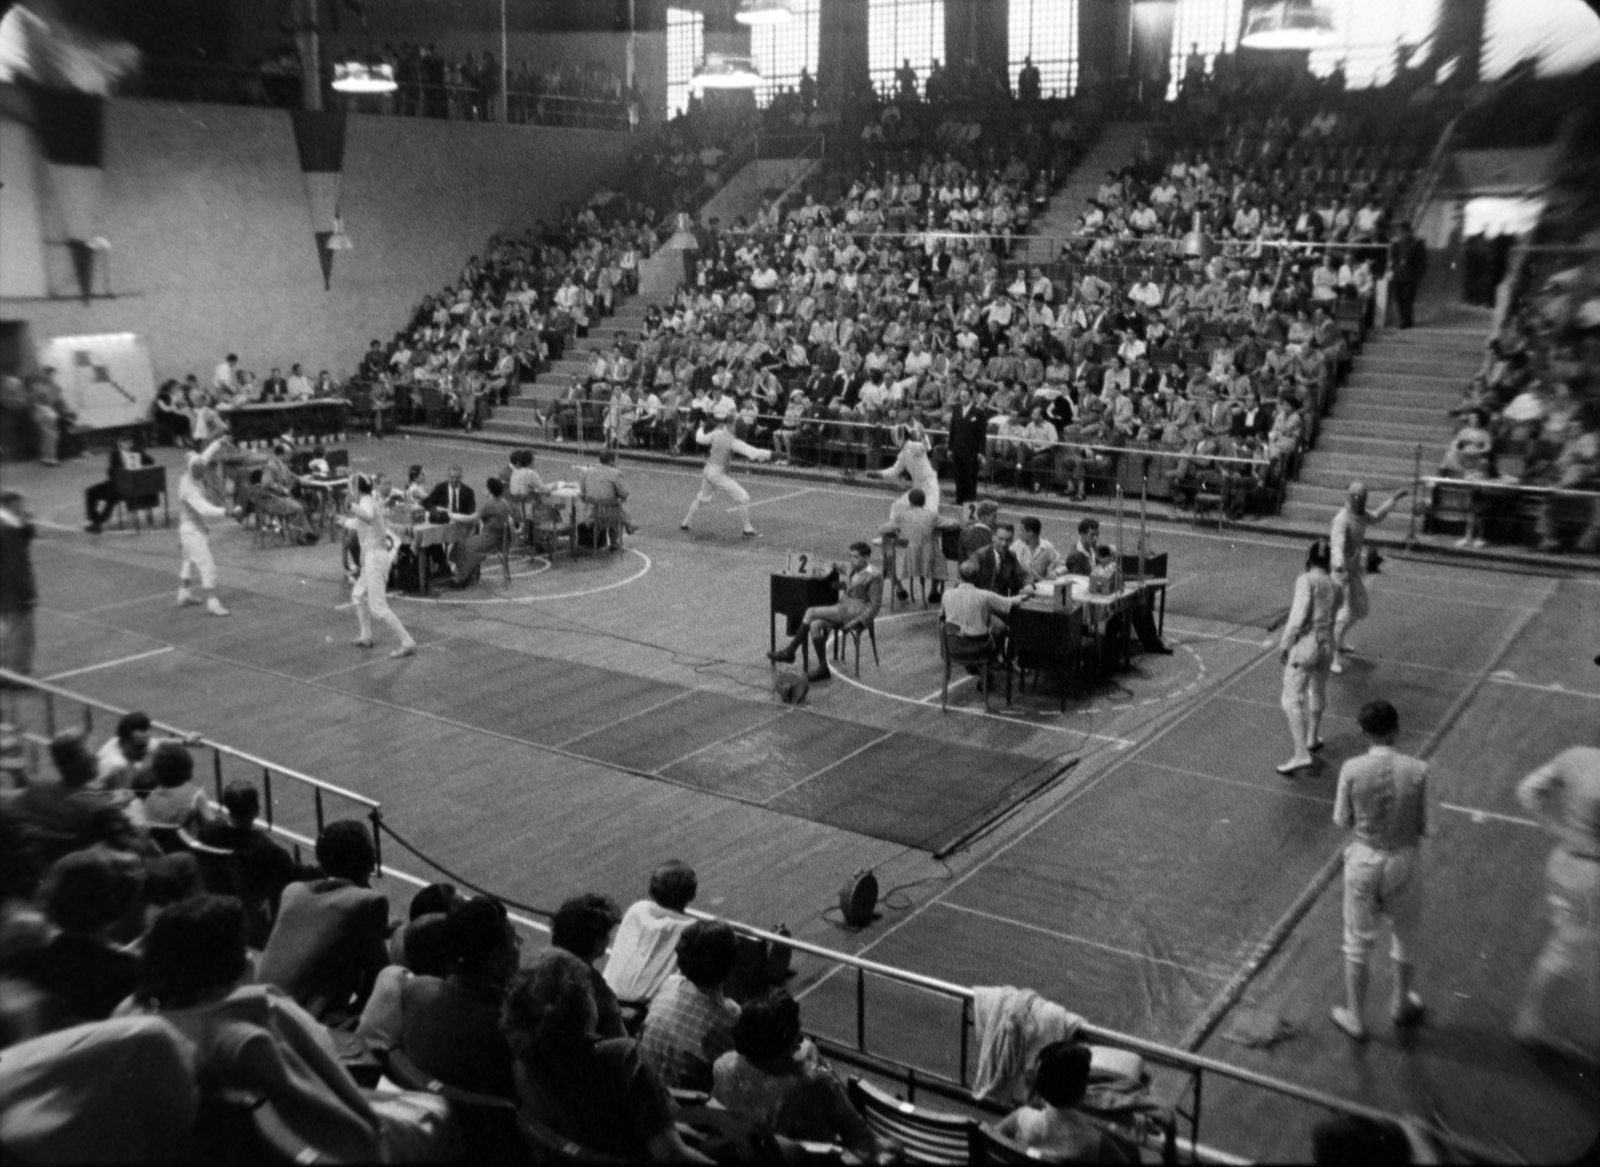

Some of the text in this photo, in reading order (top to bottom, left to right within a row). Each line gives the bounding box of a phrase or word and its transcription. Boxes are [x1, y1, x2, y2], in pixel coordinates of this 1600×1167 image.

[968, 504, 976, 520] 2
[799, 555, 808, 574] 2
[1061, 585, 1067, 606] 1
